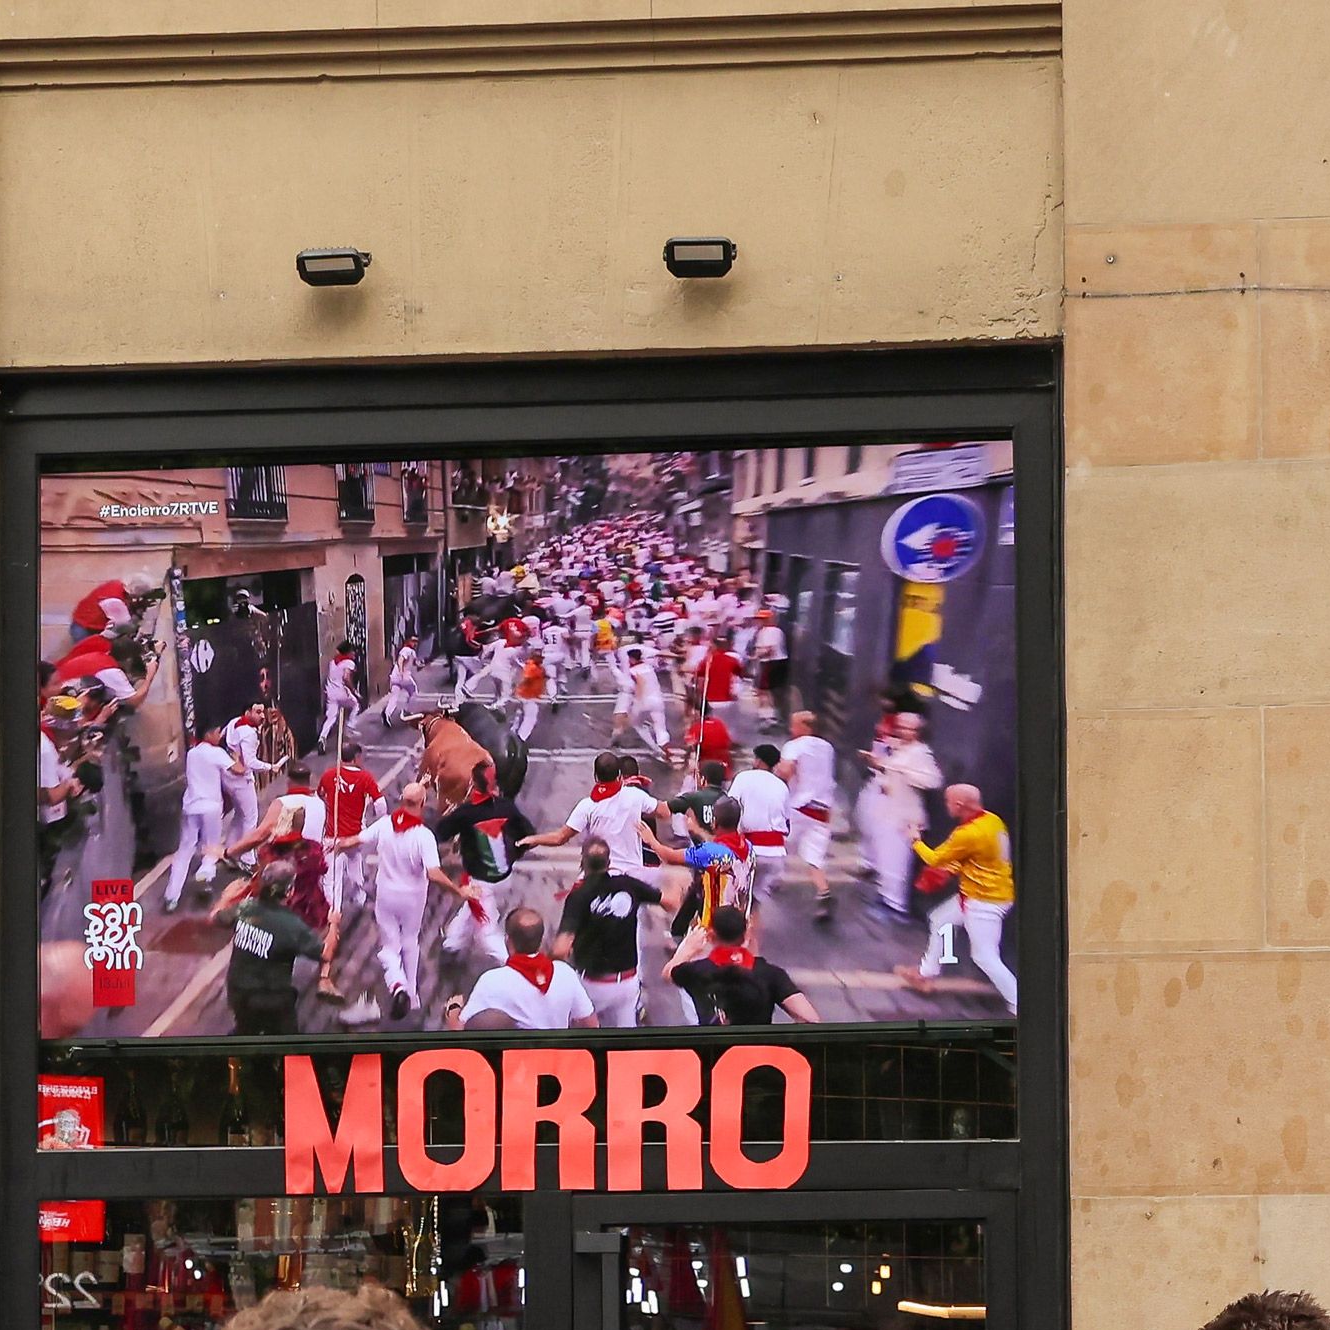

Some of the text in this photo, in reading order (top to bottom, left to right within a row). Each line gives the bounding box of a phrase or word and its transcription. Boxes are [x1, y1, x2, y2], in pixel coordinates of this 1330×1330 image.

[99, 501, 219, 518] #Encierro7RTVE
[96, 885, 129, 895] LIVE
[937, 922, 959, 964] 1
[284, 1045, 812, 1194] MORRO
